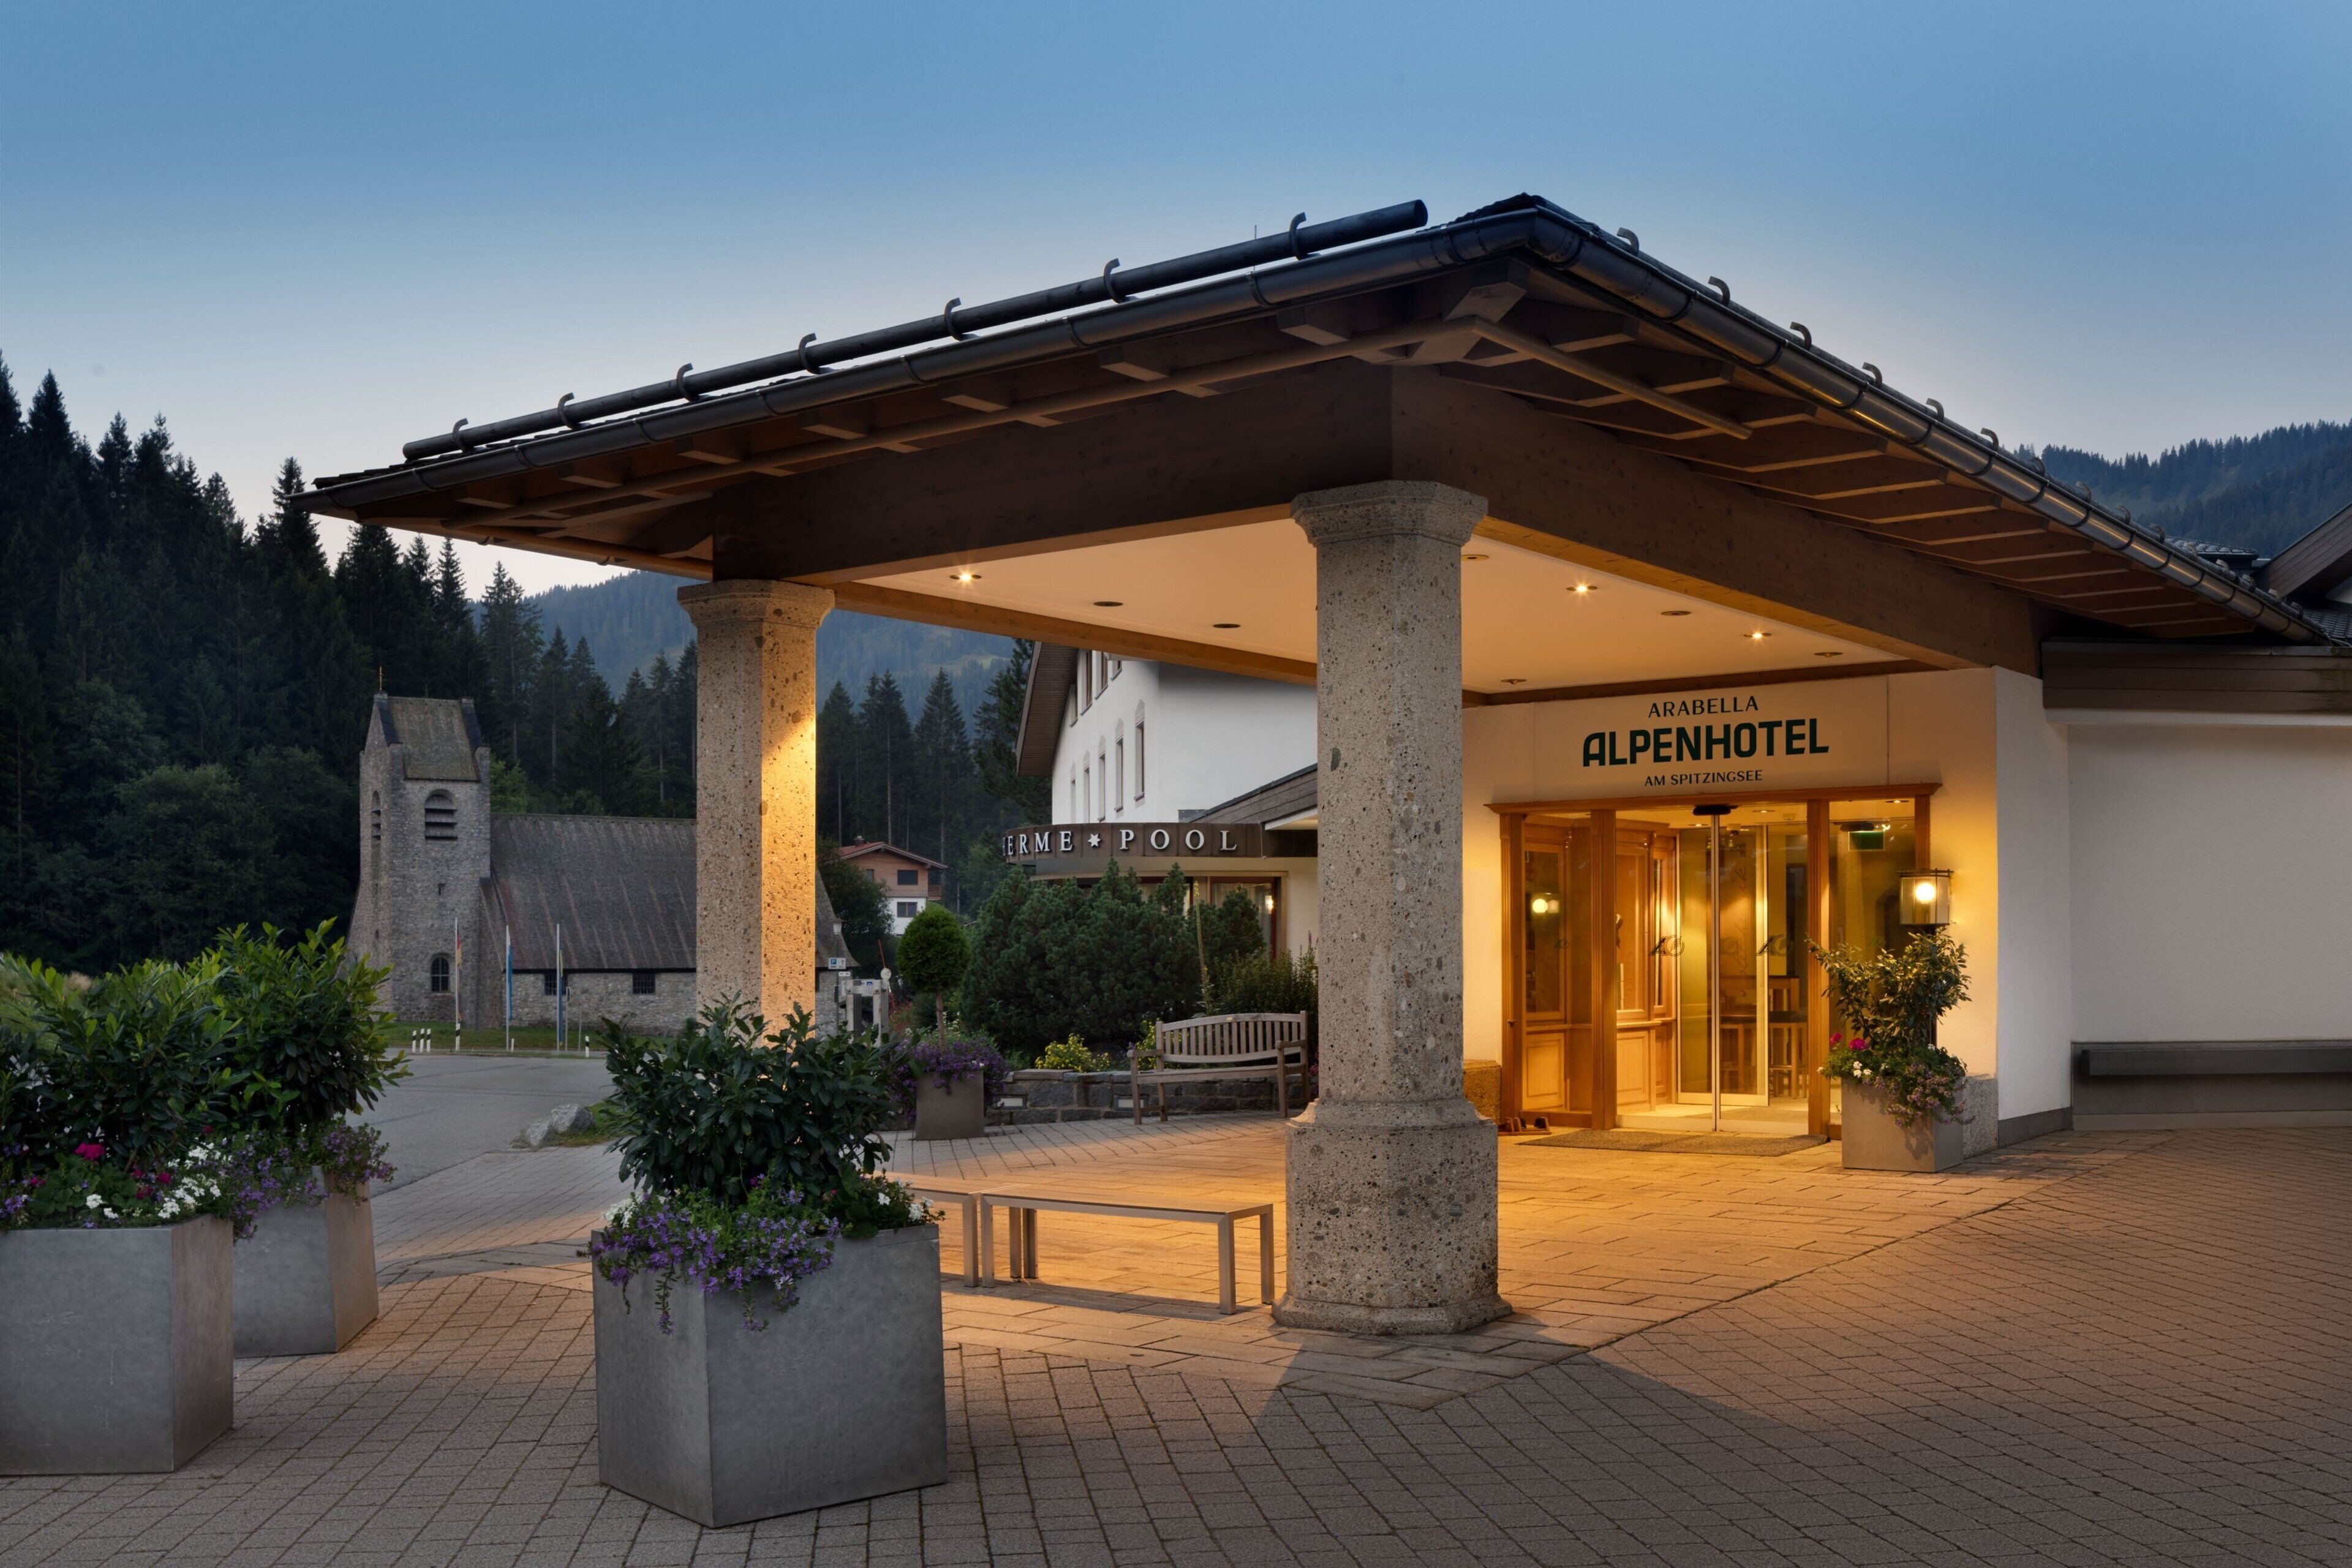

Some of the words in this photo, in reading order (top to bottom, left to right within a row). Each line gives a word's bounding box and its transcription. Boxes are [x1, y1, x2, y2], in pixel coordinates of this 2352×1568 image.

[1648, 696, 1758, 718] ARABELLA
[1583, 718, 1829, 767] ALPENHOTEL
[1644, 774, 1665, 786] AM
[1670, 770, 1763, 785] SPITZINGSEE
[1120, 829, 1237, 851] POOL
